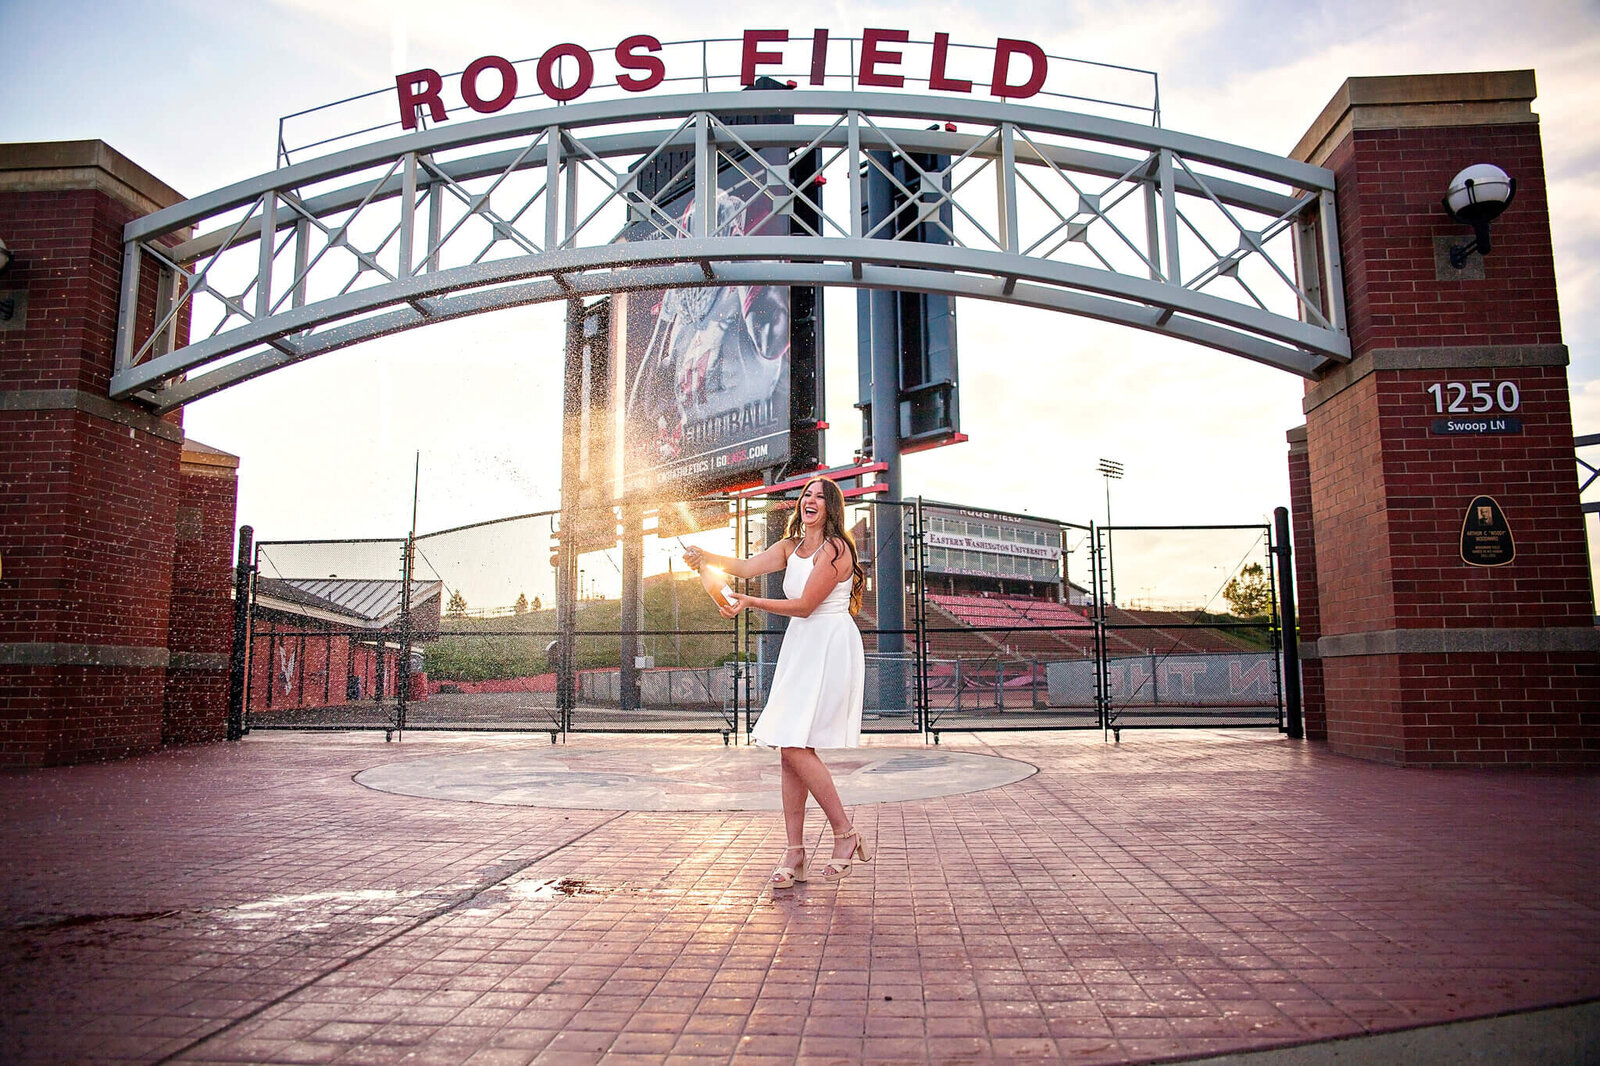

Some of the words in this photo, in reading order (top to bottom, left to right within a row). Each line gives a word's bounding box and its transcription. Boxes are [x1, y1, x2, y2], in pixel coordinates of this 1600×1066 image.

[396, 34, 666, 130] ROOS
[739, 28, 1048, 99] FIELD
[1427, 381, 1520, 413] 1250
[1447, 421, 1487, 433] Swoop
[1490, 420, 1505, 430] LN
